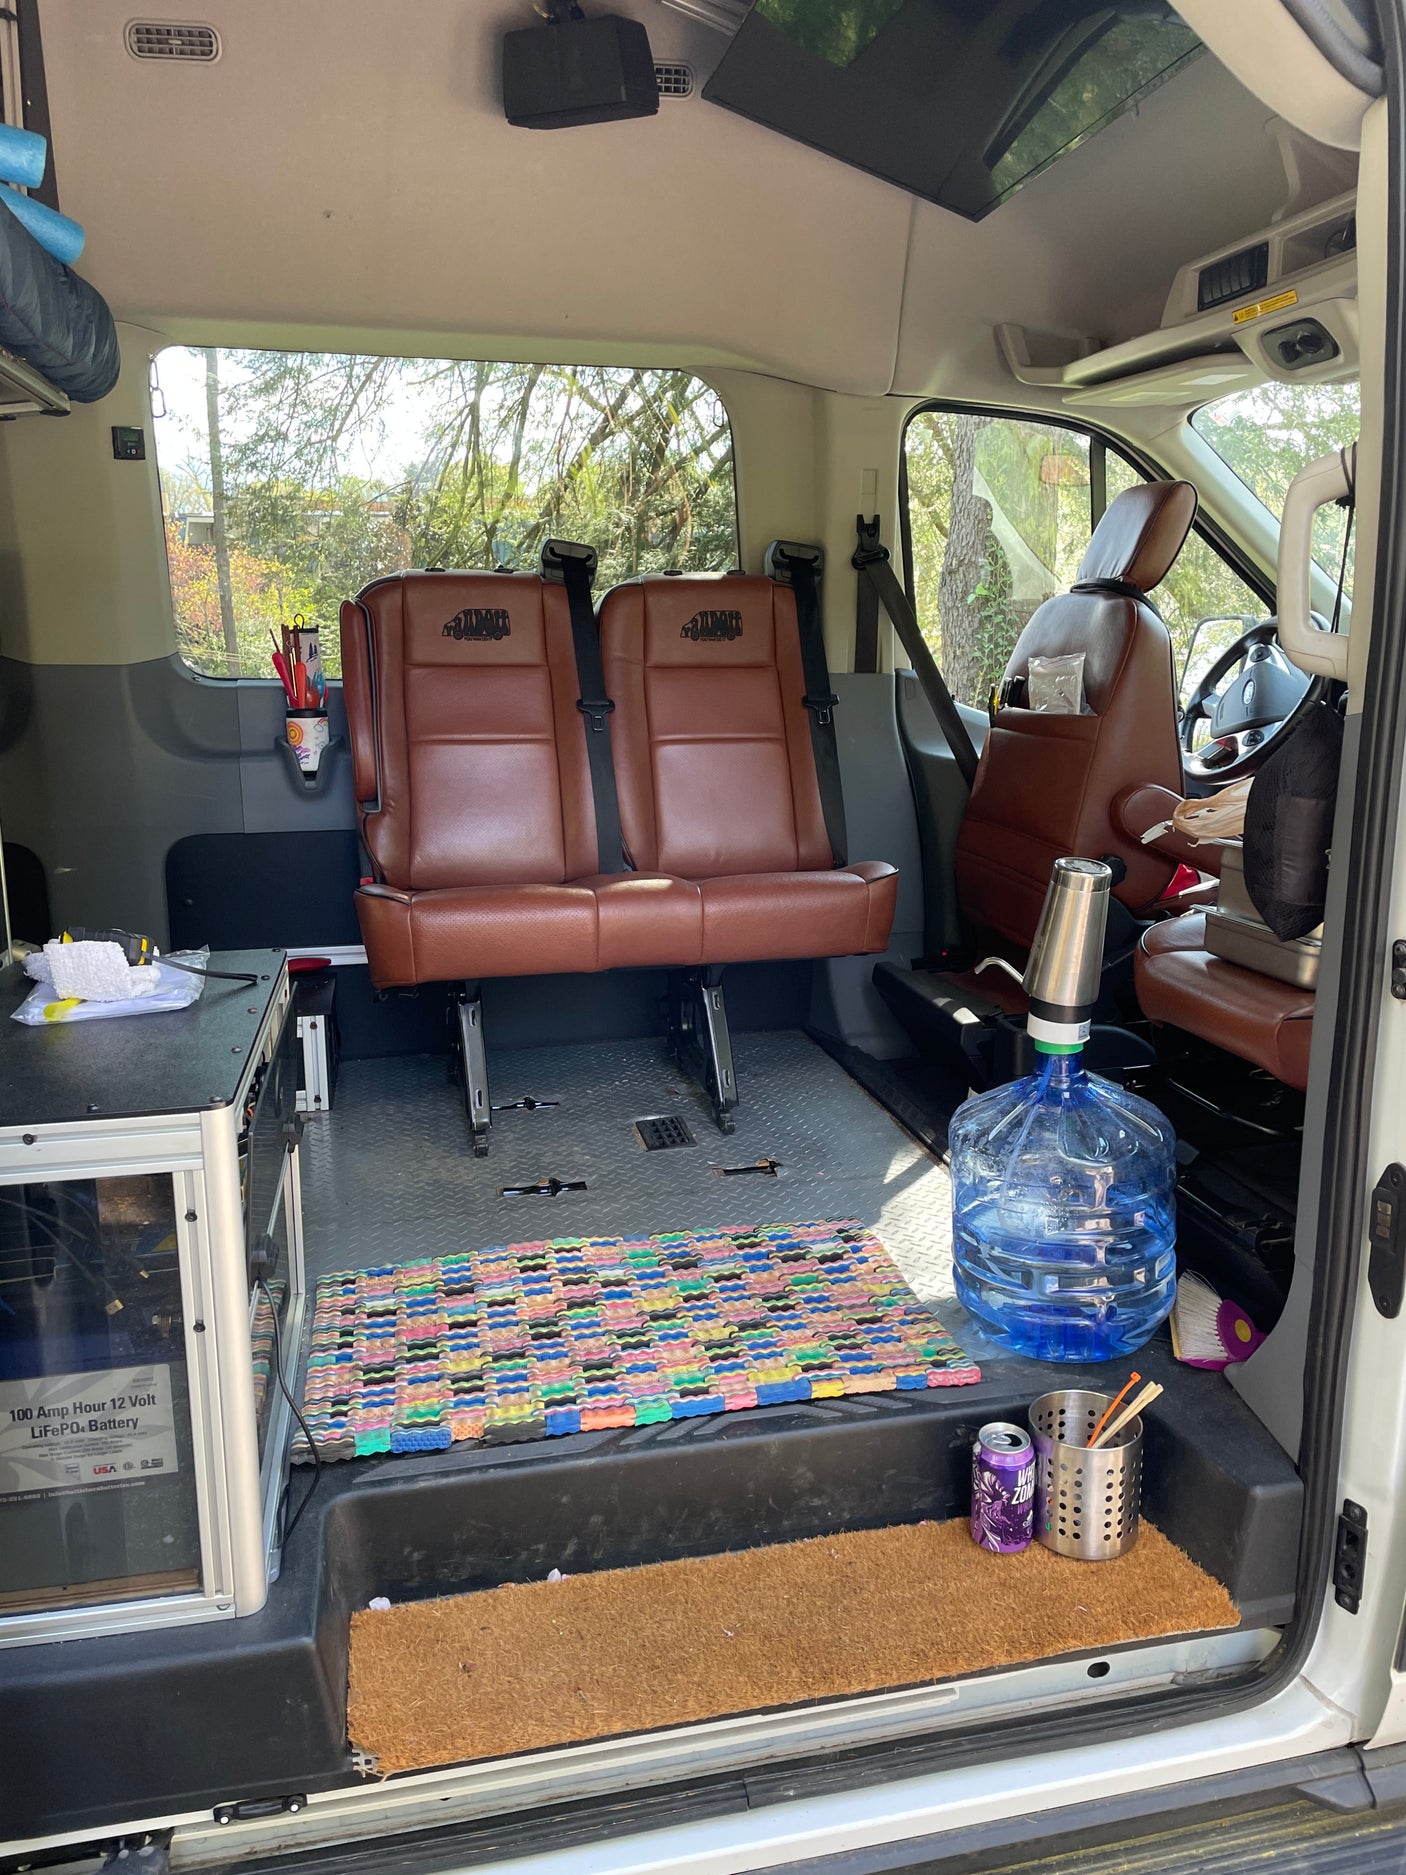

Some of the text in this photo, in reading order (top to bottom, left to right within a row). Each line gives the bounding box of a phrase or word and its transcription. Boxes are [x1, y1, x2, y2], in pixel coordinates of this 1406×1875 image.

[9, 1394, 156, 1422] 100 Amp Hour 12 Volt
[88, 1418, 139, 1432] Battery
[93, 1465, 117, 1475] USA
